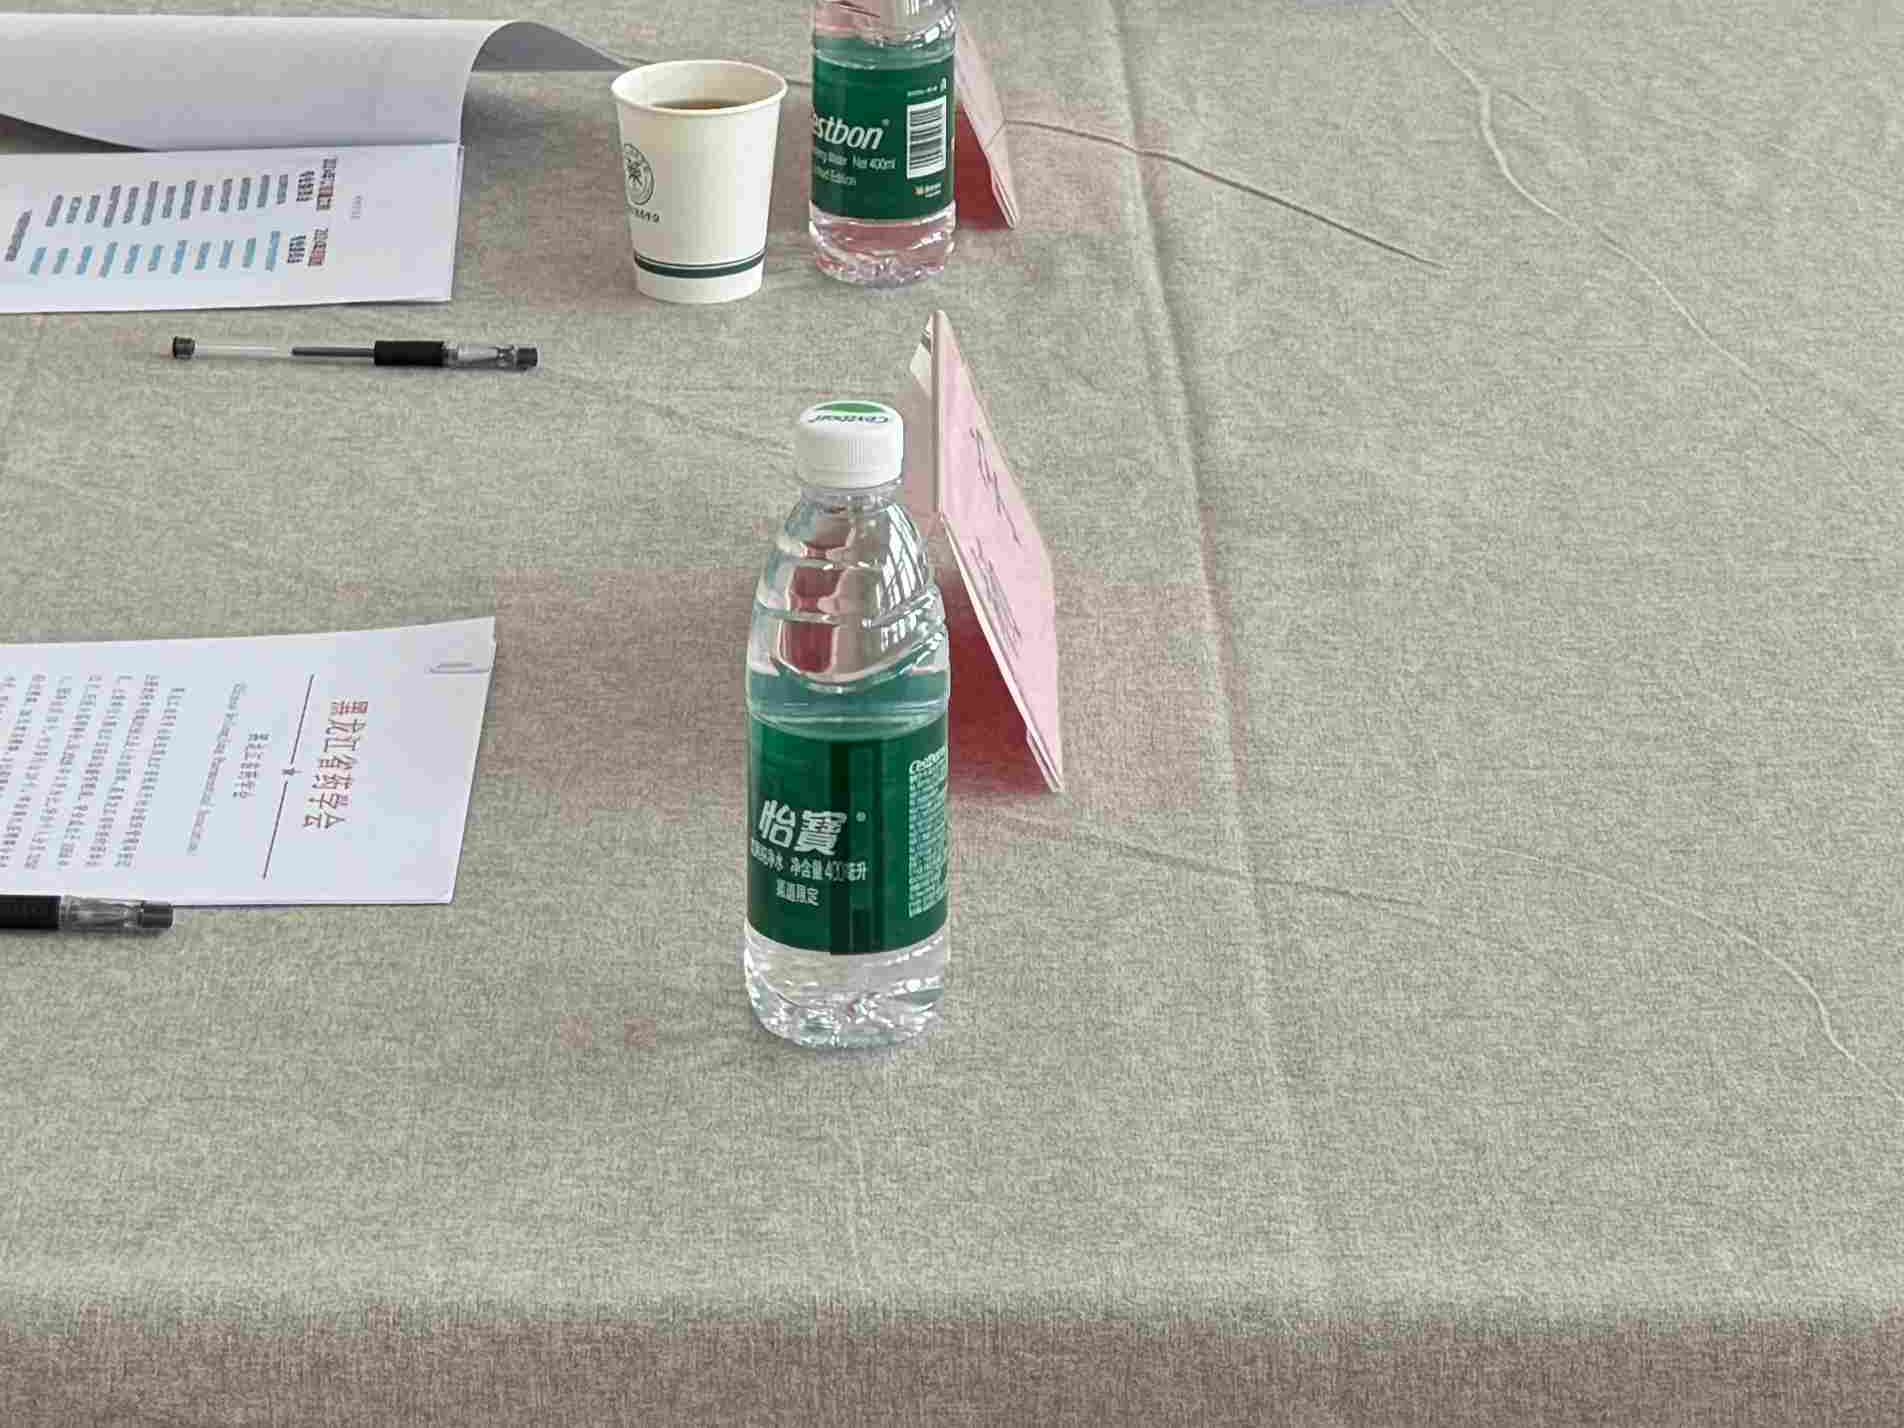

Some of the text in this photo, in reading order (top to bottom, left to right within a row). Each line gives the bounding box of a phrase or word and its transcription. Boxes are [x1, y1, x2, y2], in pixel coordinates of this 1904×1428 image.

[302, 700, 369, 830] 黑龙江省药学会
